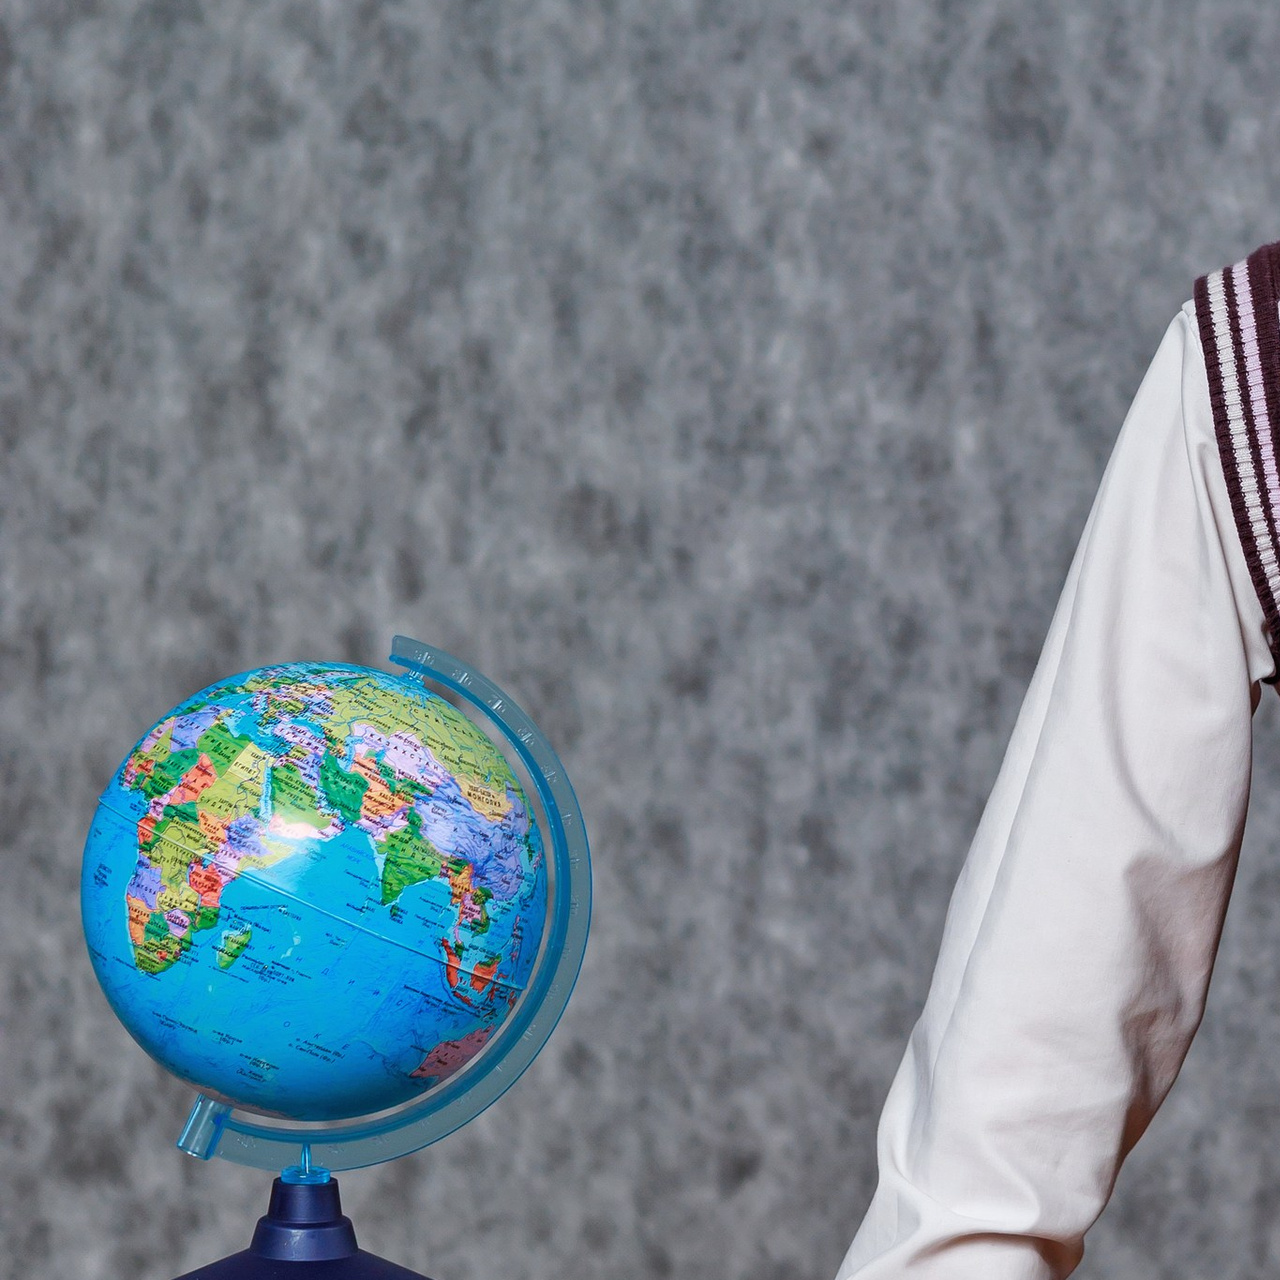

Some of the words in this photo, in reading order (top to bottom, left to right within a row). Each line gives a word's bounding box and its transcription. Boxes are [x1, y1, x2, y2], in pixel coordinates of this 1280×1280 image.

[354, 699, 374, 711] МОСКВА
[369, 733, 439, 771] КАЗАХСТАН
[233, 762, 256, 776] ЕГИПЕТ
[200, 796, 228, 812] СУДАН
[467, 791, 502, 808] МОНГОЛИЯ
[390, 843, 436, 866] ИНДИЯ
